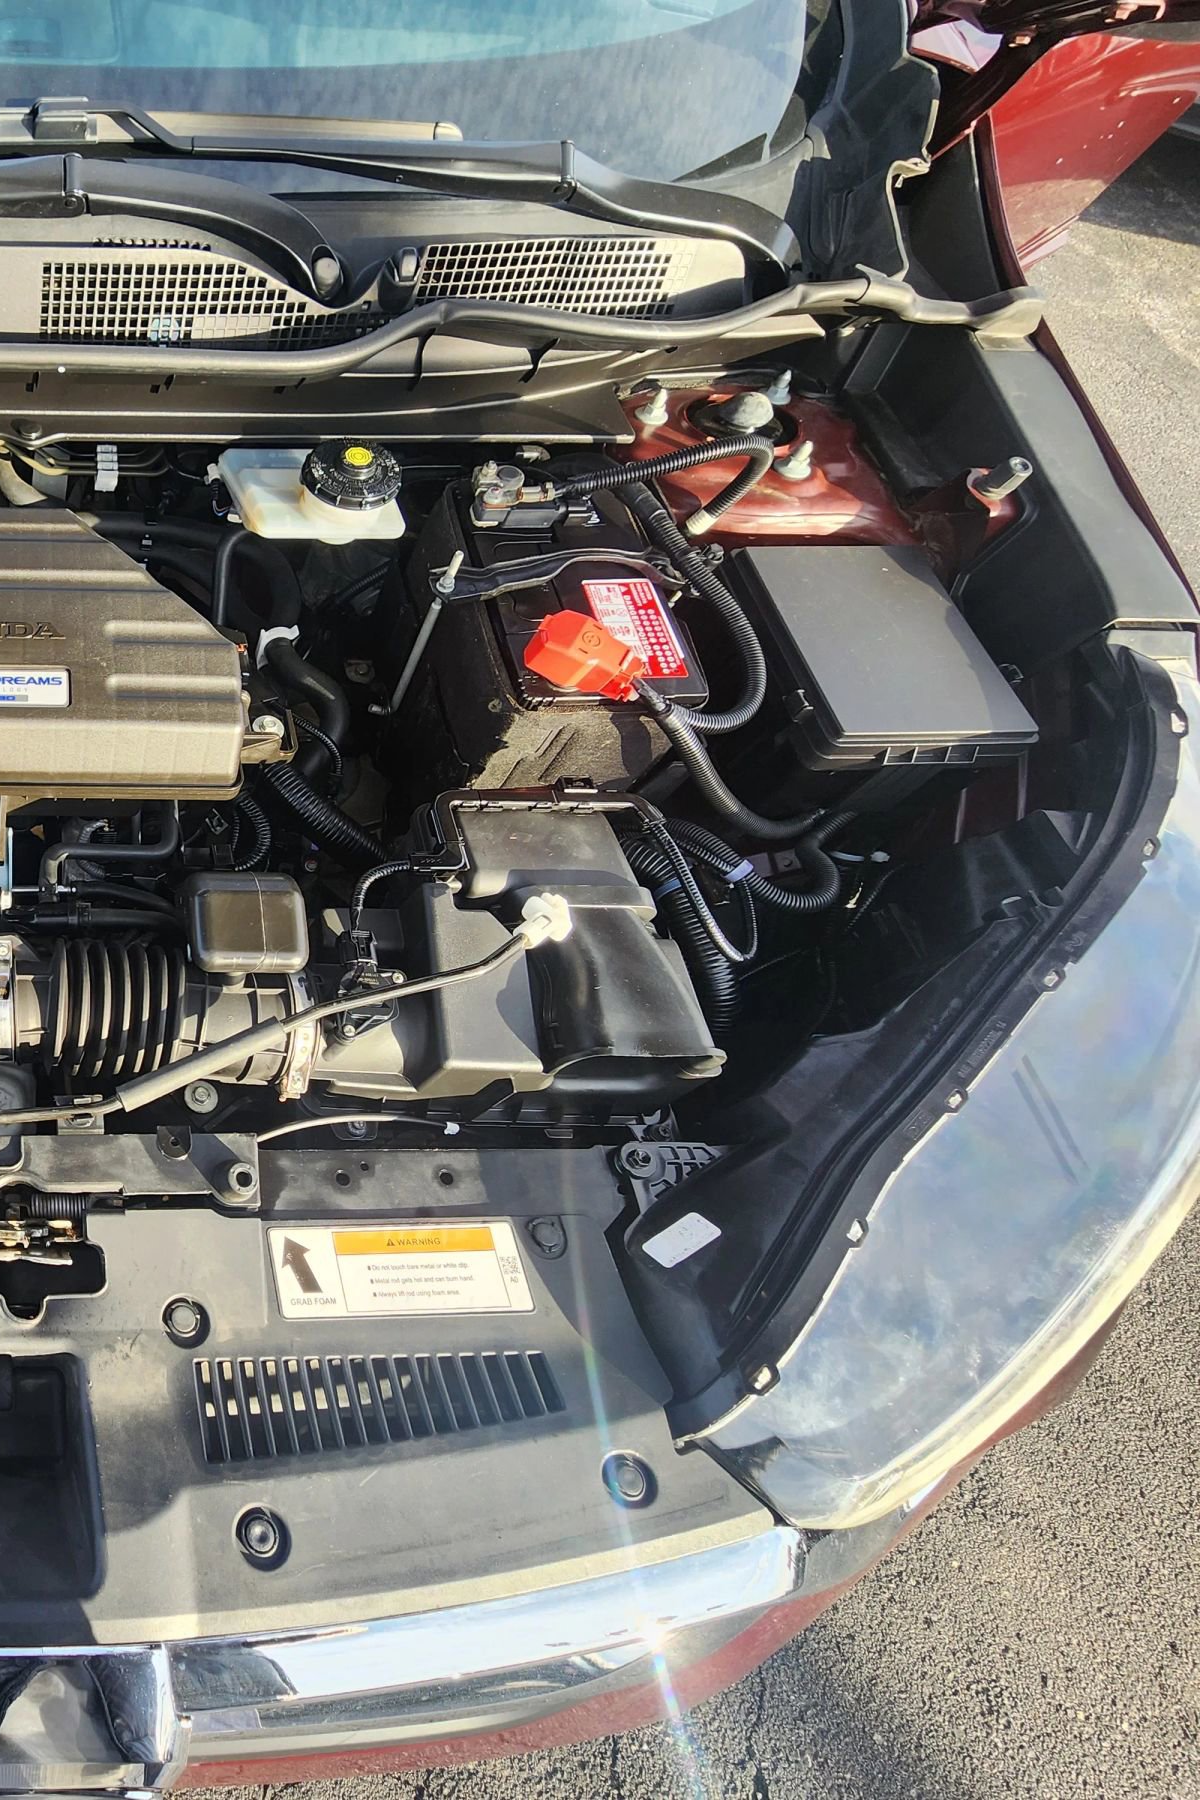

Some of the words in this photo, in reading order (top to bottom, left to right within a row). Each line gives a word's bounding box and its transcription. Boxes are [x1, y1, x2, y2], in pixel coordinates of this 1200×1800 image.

[623, 595, 655, 656] DANGER/POISON
[397, 1237, 441, 1247] WARNING
[401, 1277, 412, 1285] gets
[378, 1290, 397, 1299] Always
[416, 1290, 431, 1298] using
[290, 1297, 313, 1306] GRAB
[314, 1296, 337, 1305] FOAM
